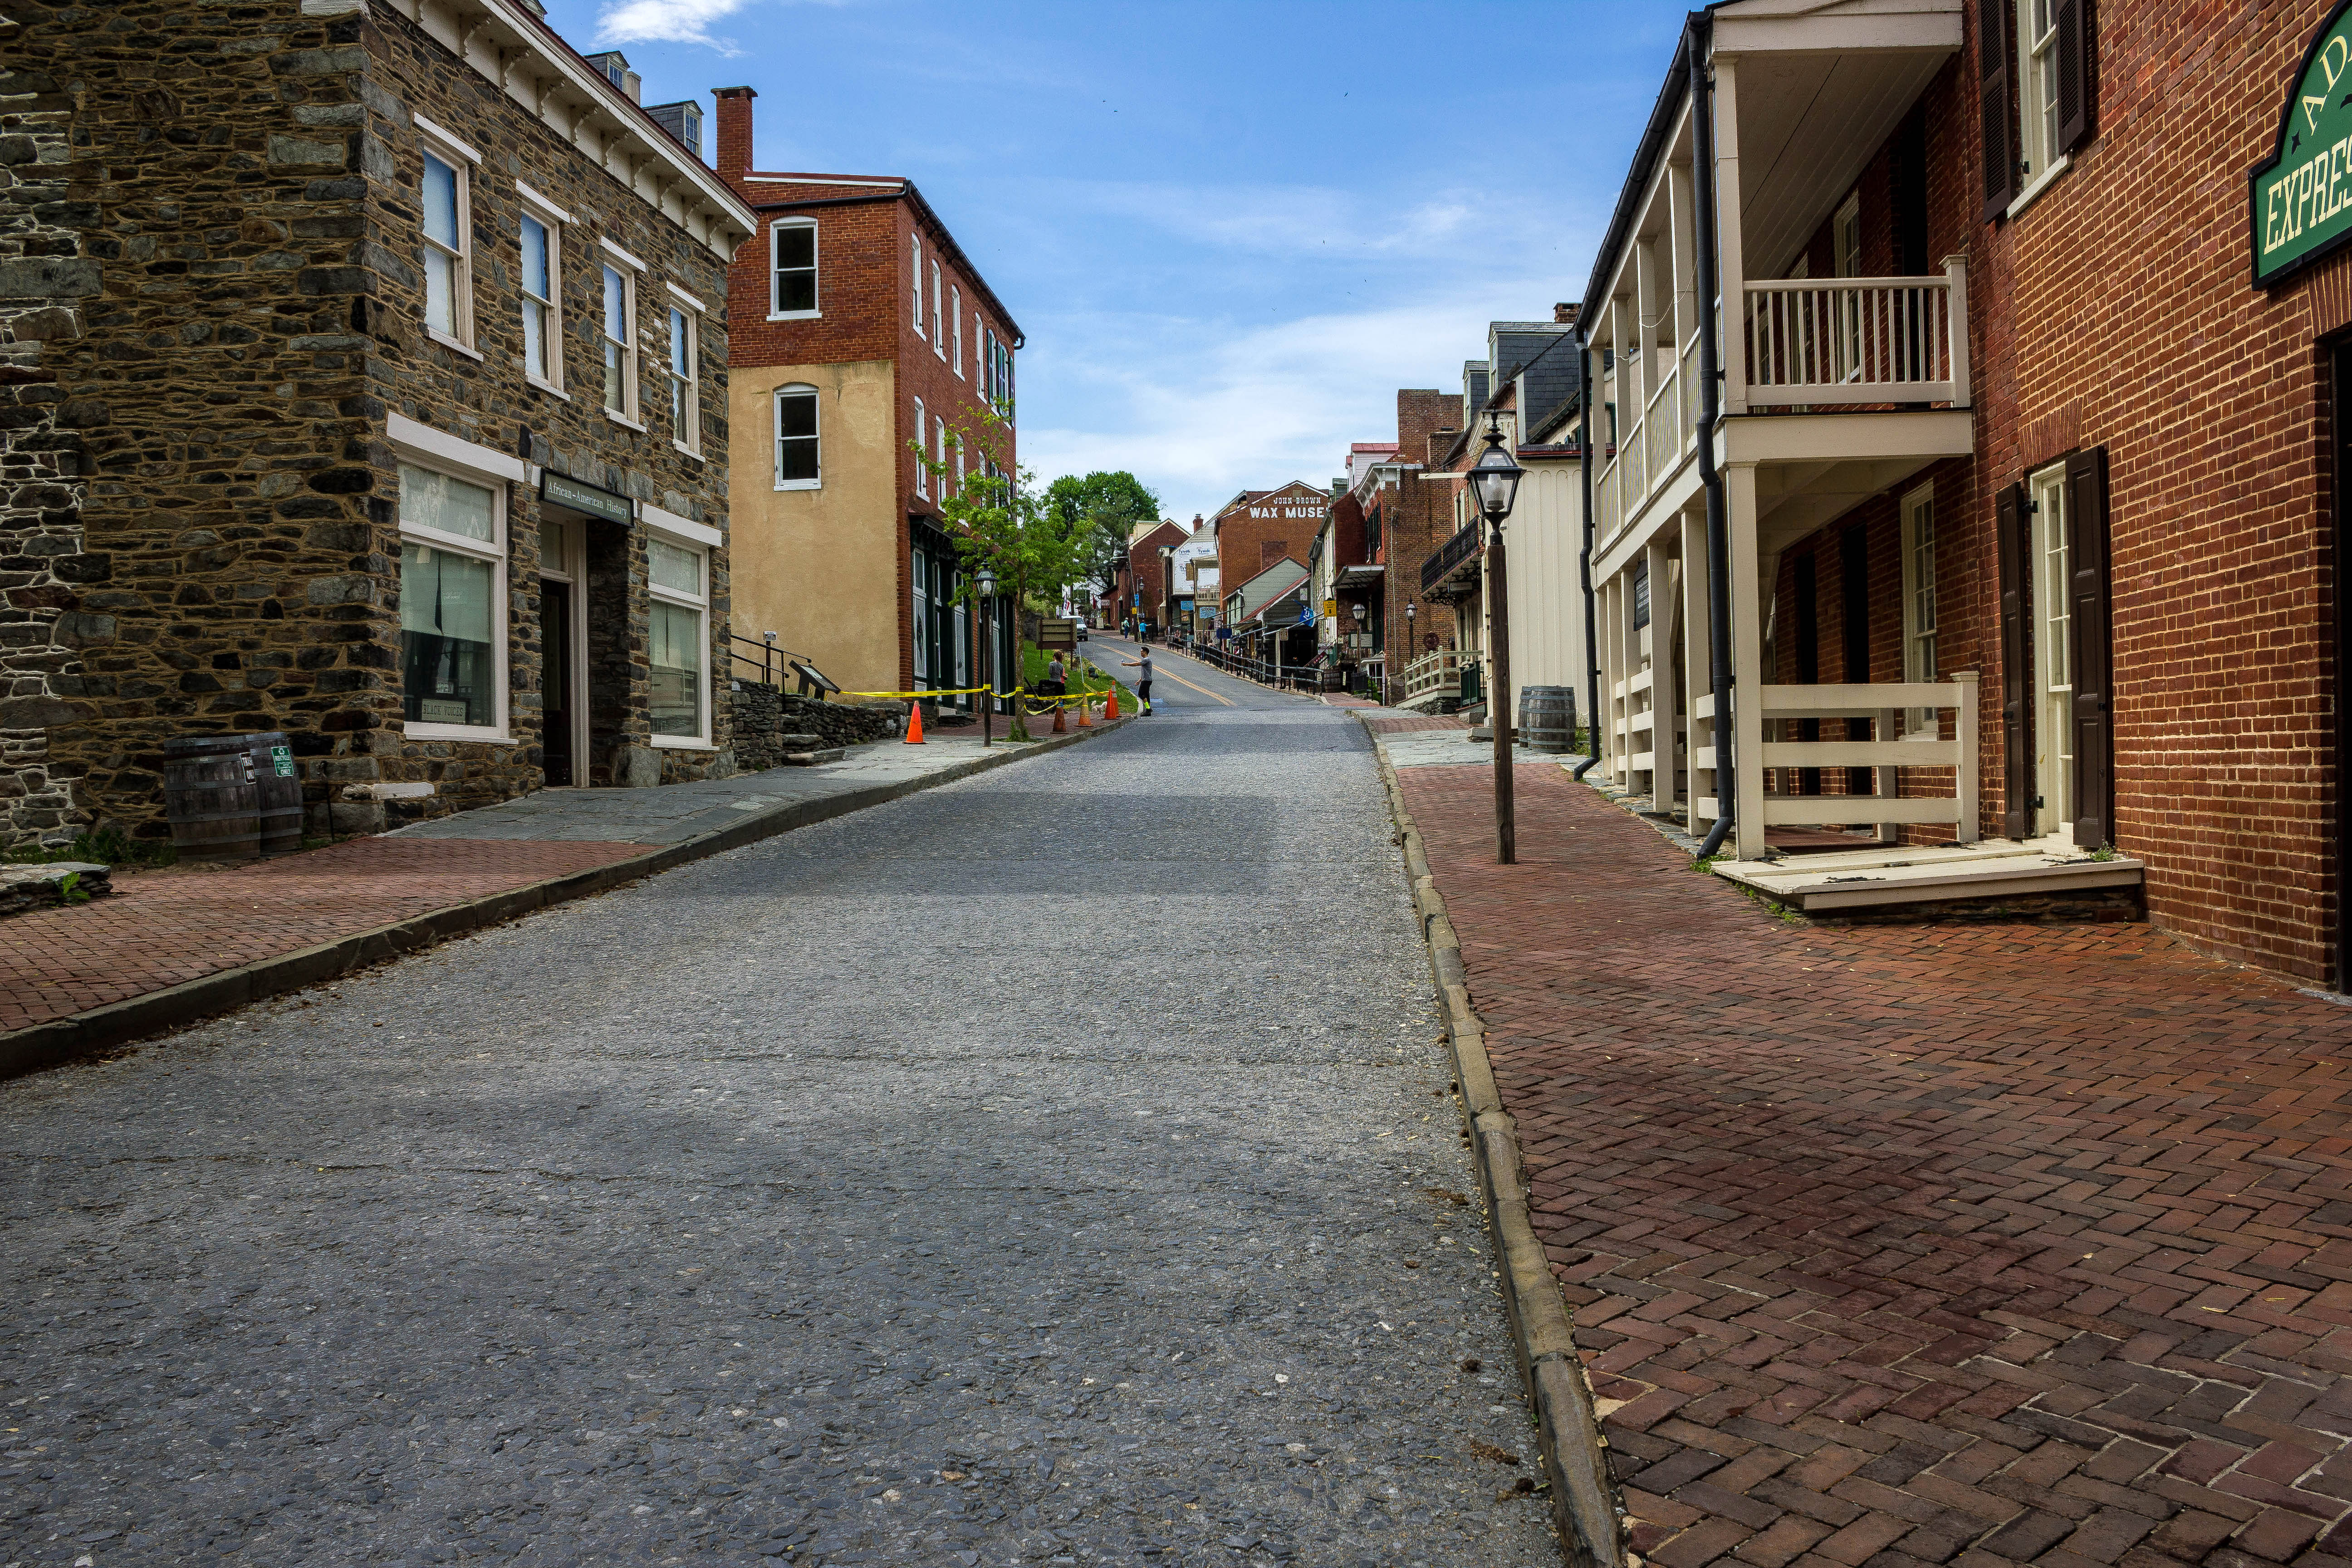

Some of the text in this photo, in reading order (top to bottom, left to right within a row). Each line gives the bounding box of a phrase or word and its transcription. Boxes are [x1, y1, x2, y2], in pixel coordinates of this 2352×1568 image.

[548, 482, 627, 519] African-American History
[1250, 507, 1328, 518] WAX MUSE
[423, 704, 463, 716] BLACK VOICES
